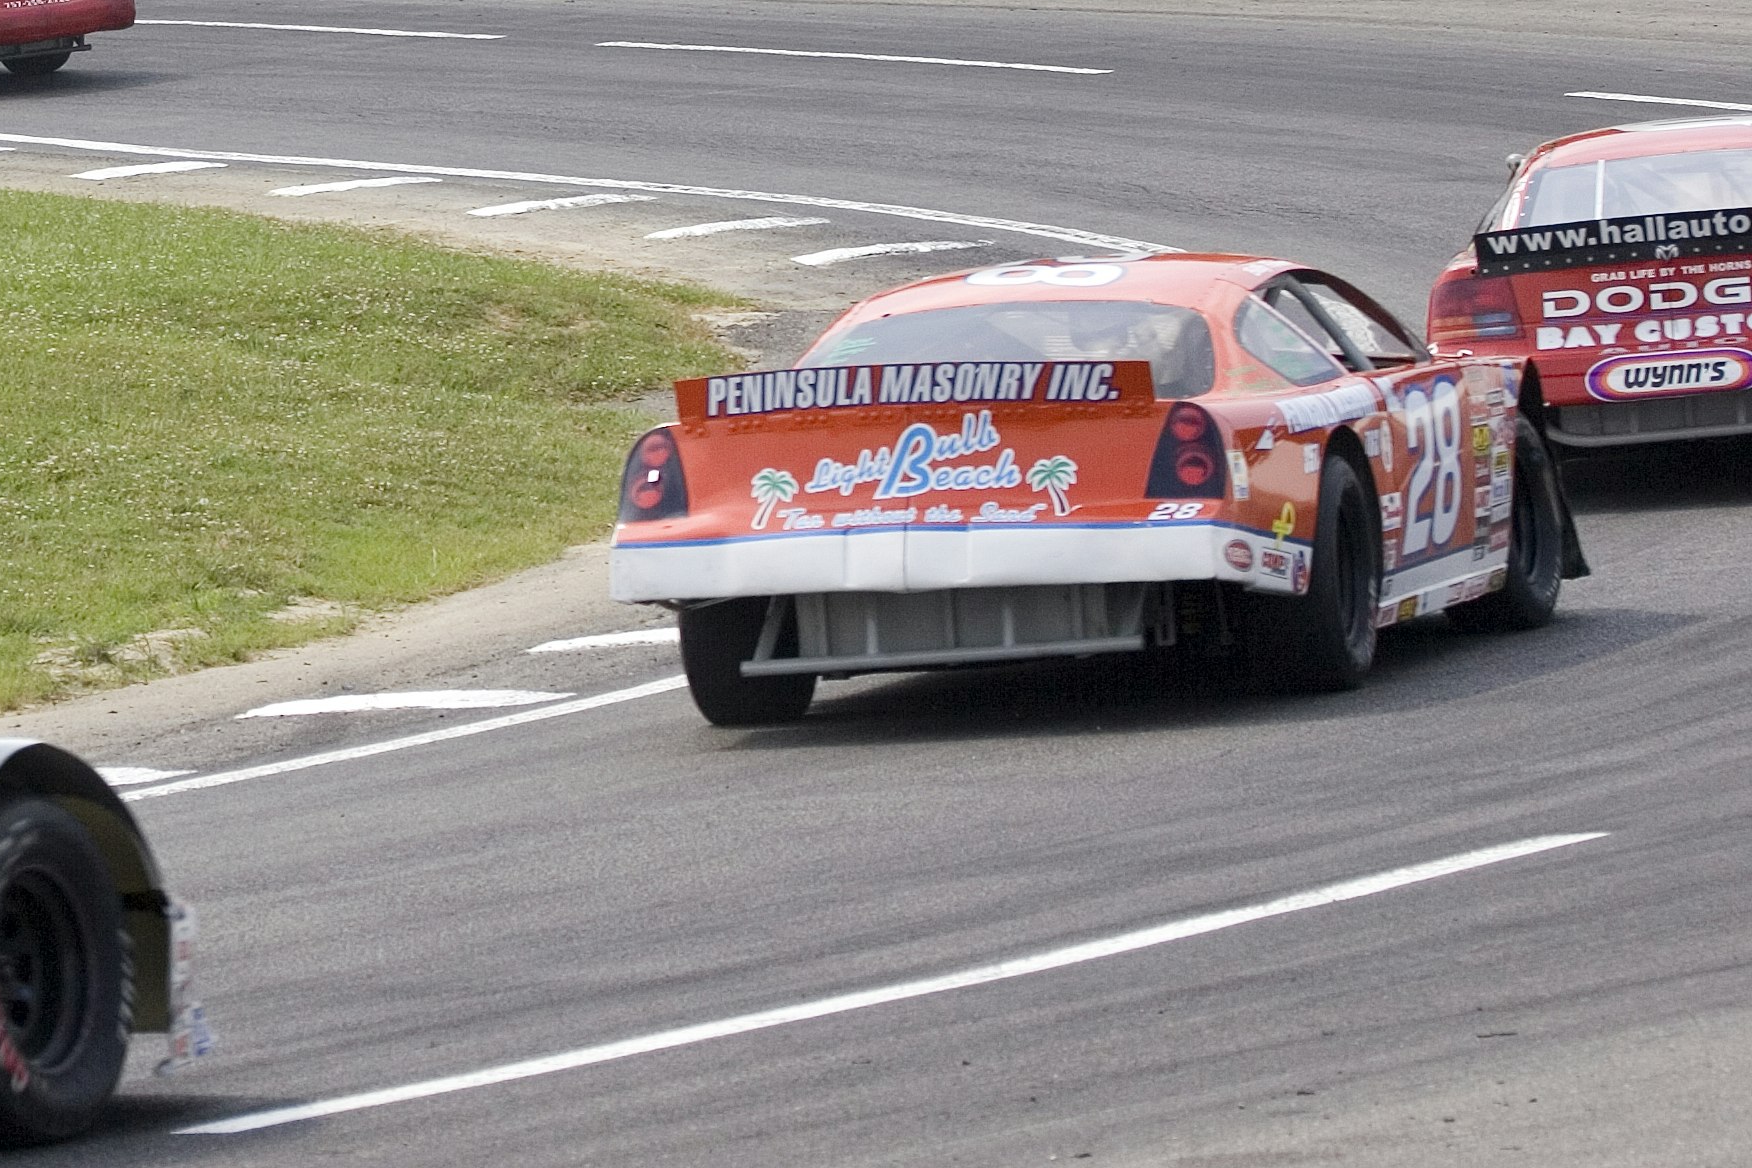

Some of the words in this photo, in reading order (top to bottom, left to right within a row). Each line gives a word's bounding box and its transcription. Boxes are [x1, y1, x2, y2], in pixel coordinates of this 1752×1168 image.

[1487, 214, 1751, 255] www.hallauto
[1591, 271, 1626, 283] GRAB
[1630, 268, 1656, 281] LIFE
[1659, 267, 1675, 277] BY
[1680, 265, 1706, 275] THE
[1709, 260, 1751, 274] HORNS
[1542, 277, 1751, 318] DODG
[1536, 324, 1621, 350] BAY
[1634, 312, 1752, 344] CUST
[706, 366, 872, 417] PENINSULA
[879, 362, 1043, 404] MASONRY
[1047, 360, 1122, 402] INC.
[805, 447, 892, 496] Light
[1403, 374, 1462, 557] 28
[1148, 503, 1204, 520] 28
